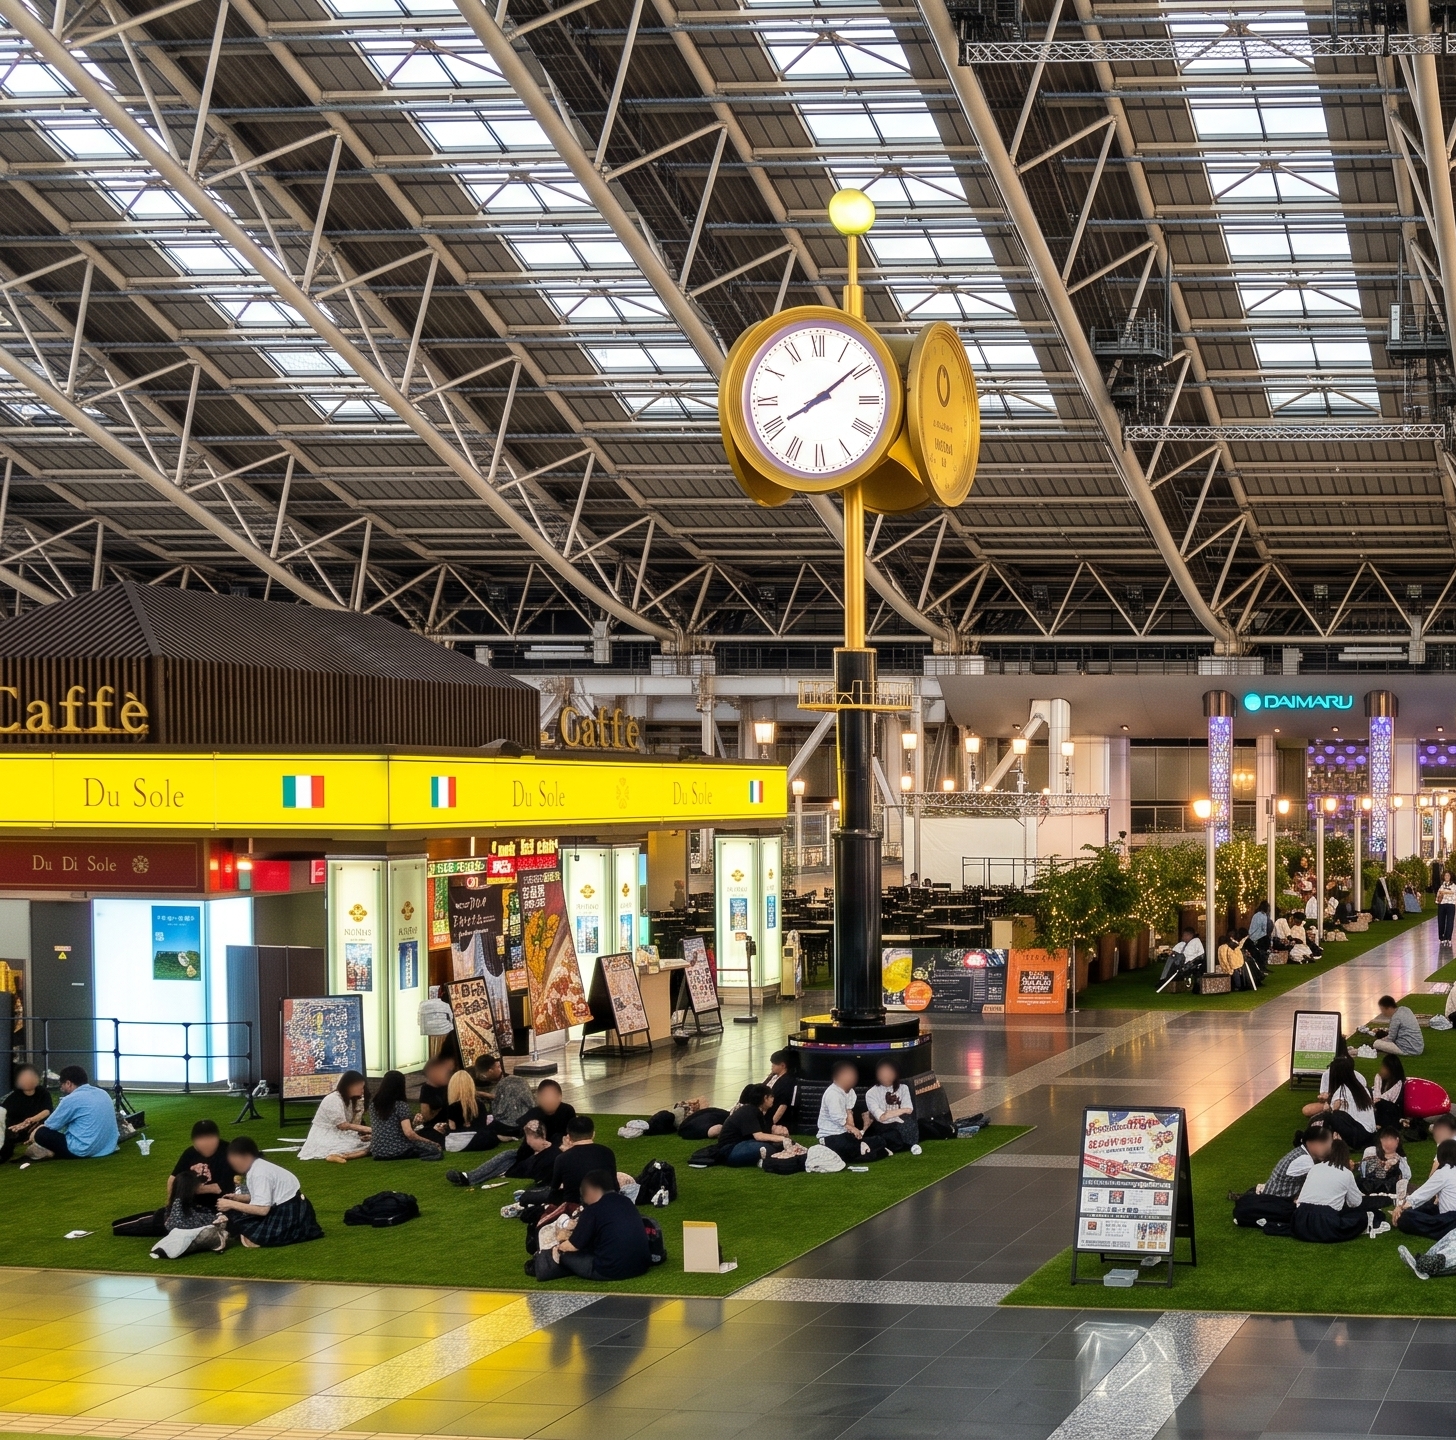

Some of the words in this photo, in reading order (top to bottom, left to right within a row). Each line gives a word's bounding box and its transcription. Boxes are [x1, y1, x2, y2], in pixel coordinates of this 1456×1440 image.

[0, 685, 149, 733] Caffè
[1264, 695, 1353, 709] DAIMARU
[83, 777, 120, 807] Du
[133, 777, 184, 808] Sole
[512, 780, 532, 807] Du
[538, 780, 566, 808] Sole
[672, 781, 688, 806] Du
[691, 780, 713, 806] Sole
[32, 855, 53, 871] Du
[62, 856, 79, 871] Di
[87, 855, 117, 872] Sole
